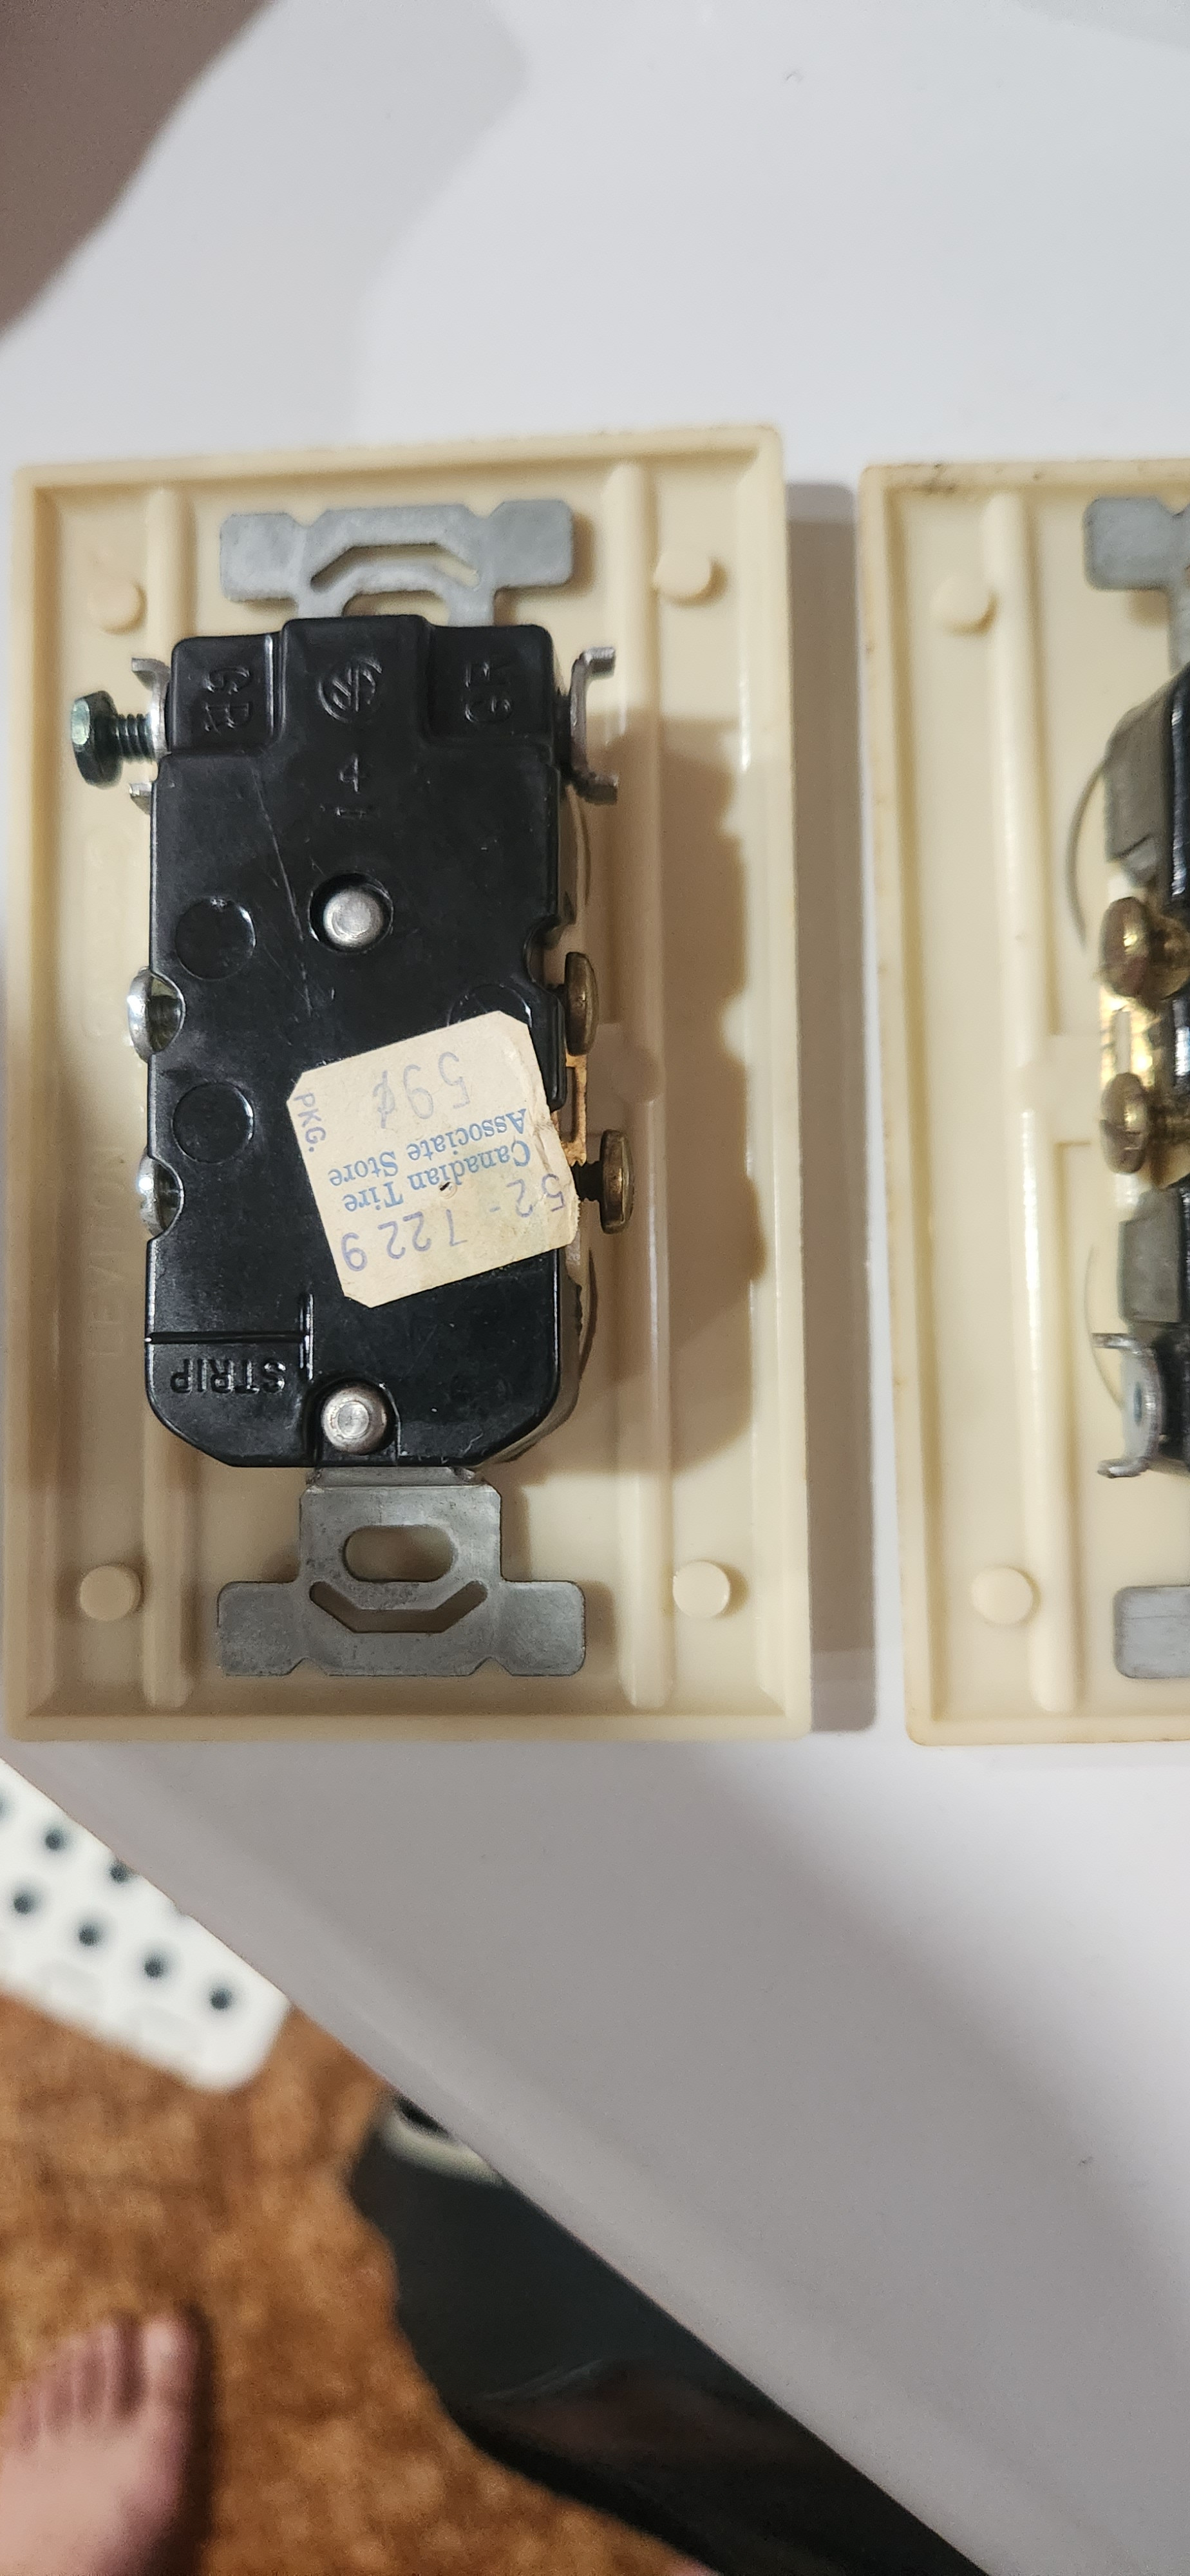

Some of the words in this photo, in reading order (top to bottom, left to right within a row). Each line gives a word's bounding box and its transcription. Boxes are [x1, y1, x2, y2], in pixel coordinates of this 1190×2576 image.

[294, 1091, 326, 1153] PKG.
[407, 1108, 527, 1162] Associate
[328, 1150, 399, 1187] Store
[408, 1139, 531, 1191] Canadian
[343, 1180, 404, 1213] Tire
[170, 1358, 287, 1395] STRIP
